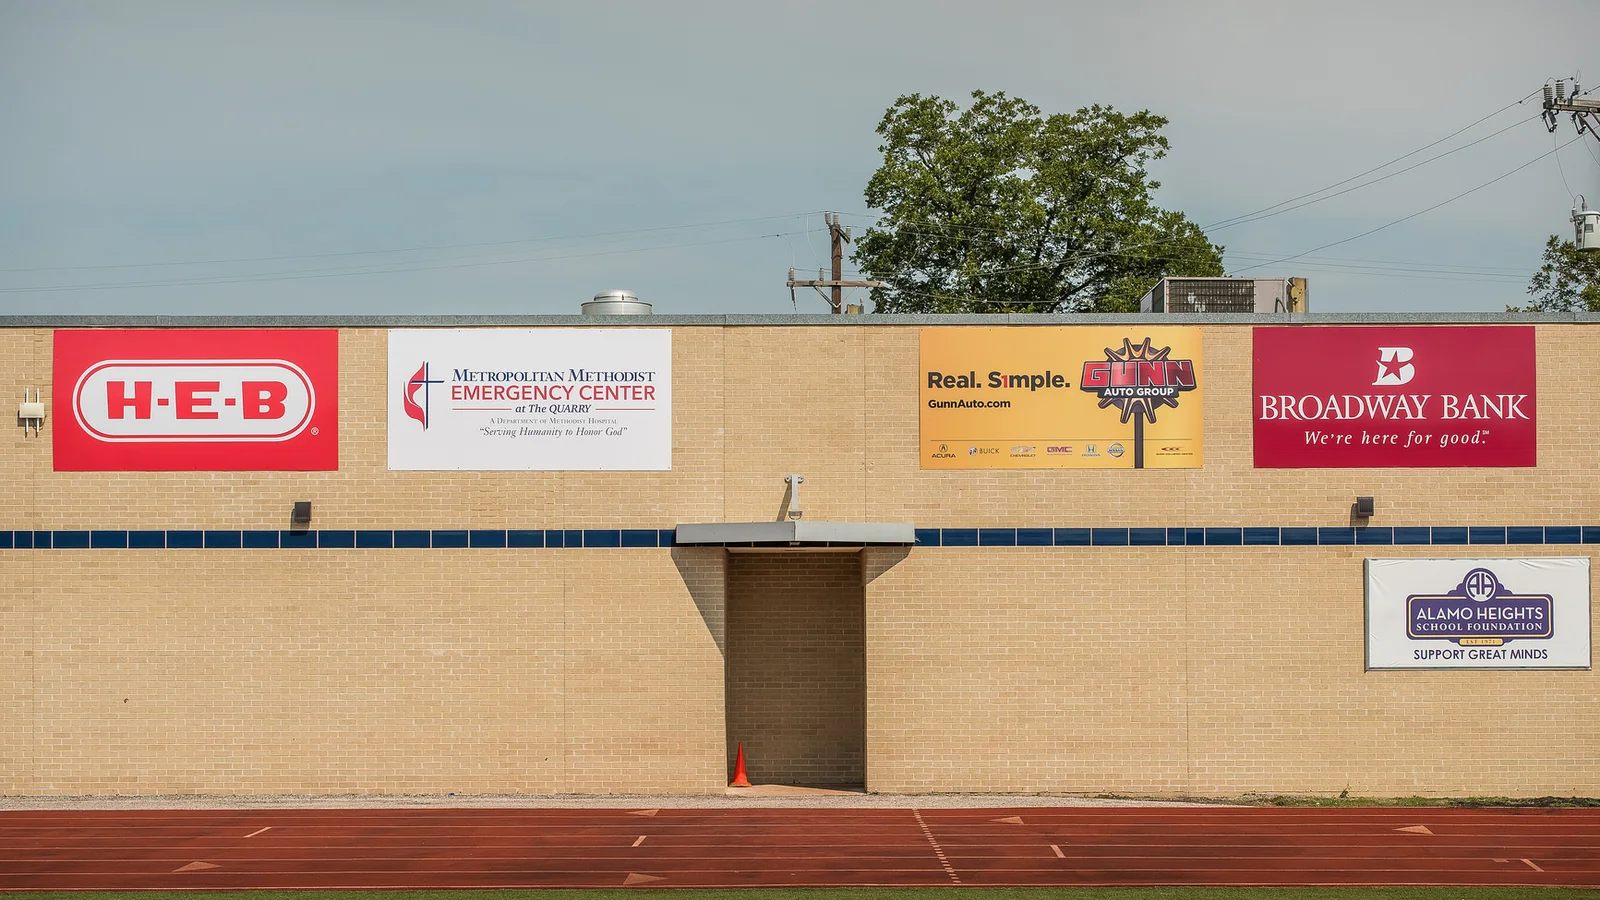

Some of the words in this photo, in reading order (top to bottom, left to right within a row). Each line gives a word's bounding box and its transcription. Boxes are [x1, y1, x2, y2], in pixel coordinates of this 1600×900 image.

[452, 368, 565, 382] METROPOLITAN
[568, 368, 656, 382] METHODIST
[928, 371, 982, 389] Real.
[988, 370, 1071, 391] S1mple.
[1082, 361, 1194, 387] GUNN
[451, 385, 574, 400] EMERGENCY
[579, 385, 656, 400] CENTER
[1104, 387, 1134, 396] AUTO
[1136, 387, 1174, 396] GROUP
[106, 381, 288, 420] H-E-B
[928, 399, 1011, 408] GunnAuto.com
[515, 405, 527, 413] at
[528, 404, 547, 413] The
[549, 404, 592, 414] QUARRY
[1259, 394, 1431, 421] BROADWAY
[1440, 394, 1531, 420] BANK
[479, 427, 517, 438] “Serving
[519, 427, 563, 438] Humanity
[565, 428, 573, 436] to
[576, 427, 603, 436] Honor
[605, 427, 628, 436] God”
[1304, 430, 1352, 445] We're
[1361, 430, 1398, 445] here
[1403, 430, 1432, 448] for
[1416, 607, 1473, 620] ALAMO
[1477, 607, 1543, 620] HEIGHTS
[1416, 622, 1463, 631] SCHOOL
[1467, 622, 1543, 631] FOUNDATION
[1413, 649, 1465, 660] SUPPORT
[1468, 649, 1508, 660] GREAT
[1509, 649, 1548, 659] MINDS
